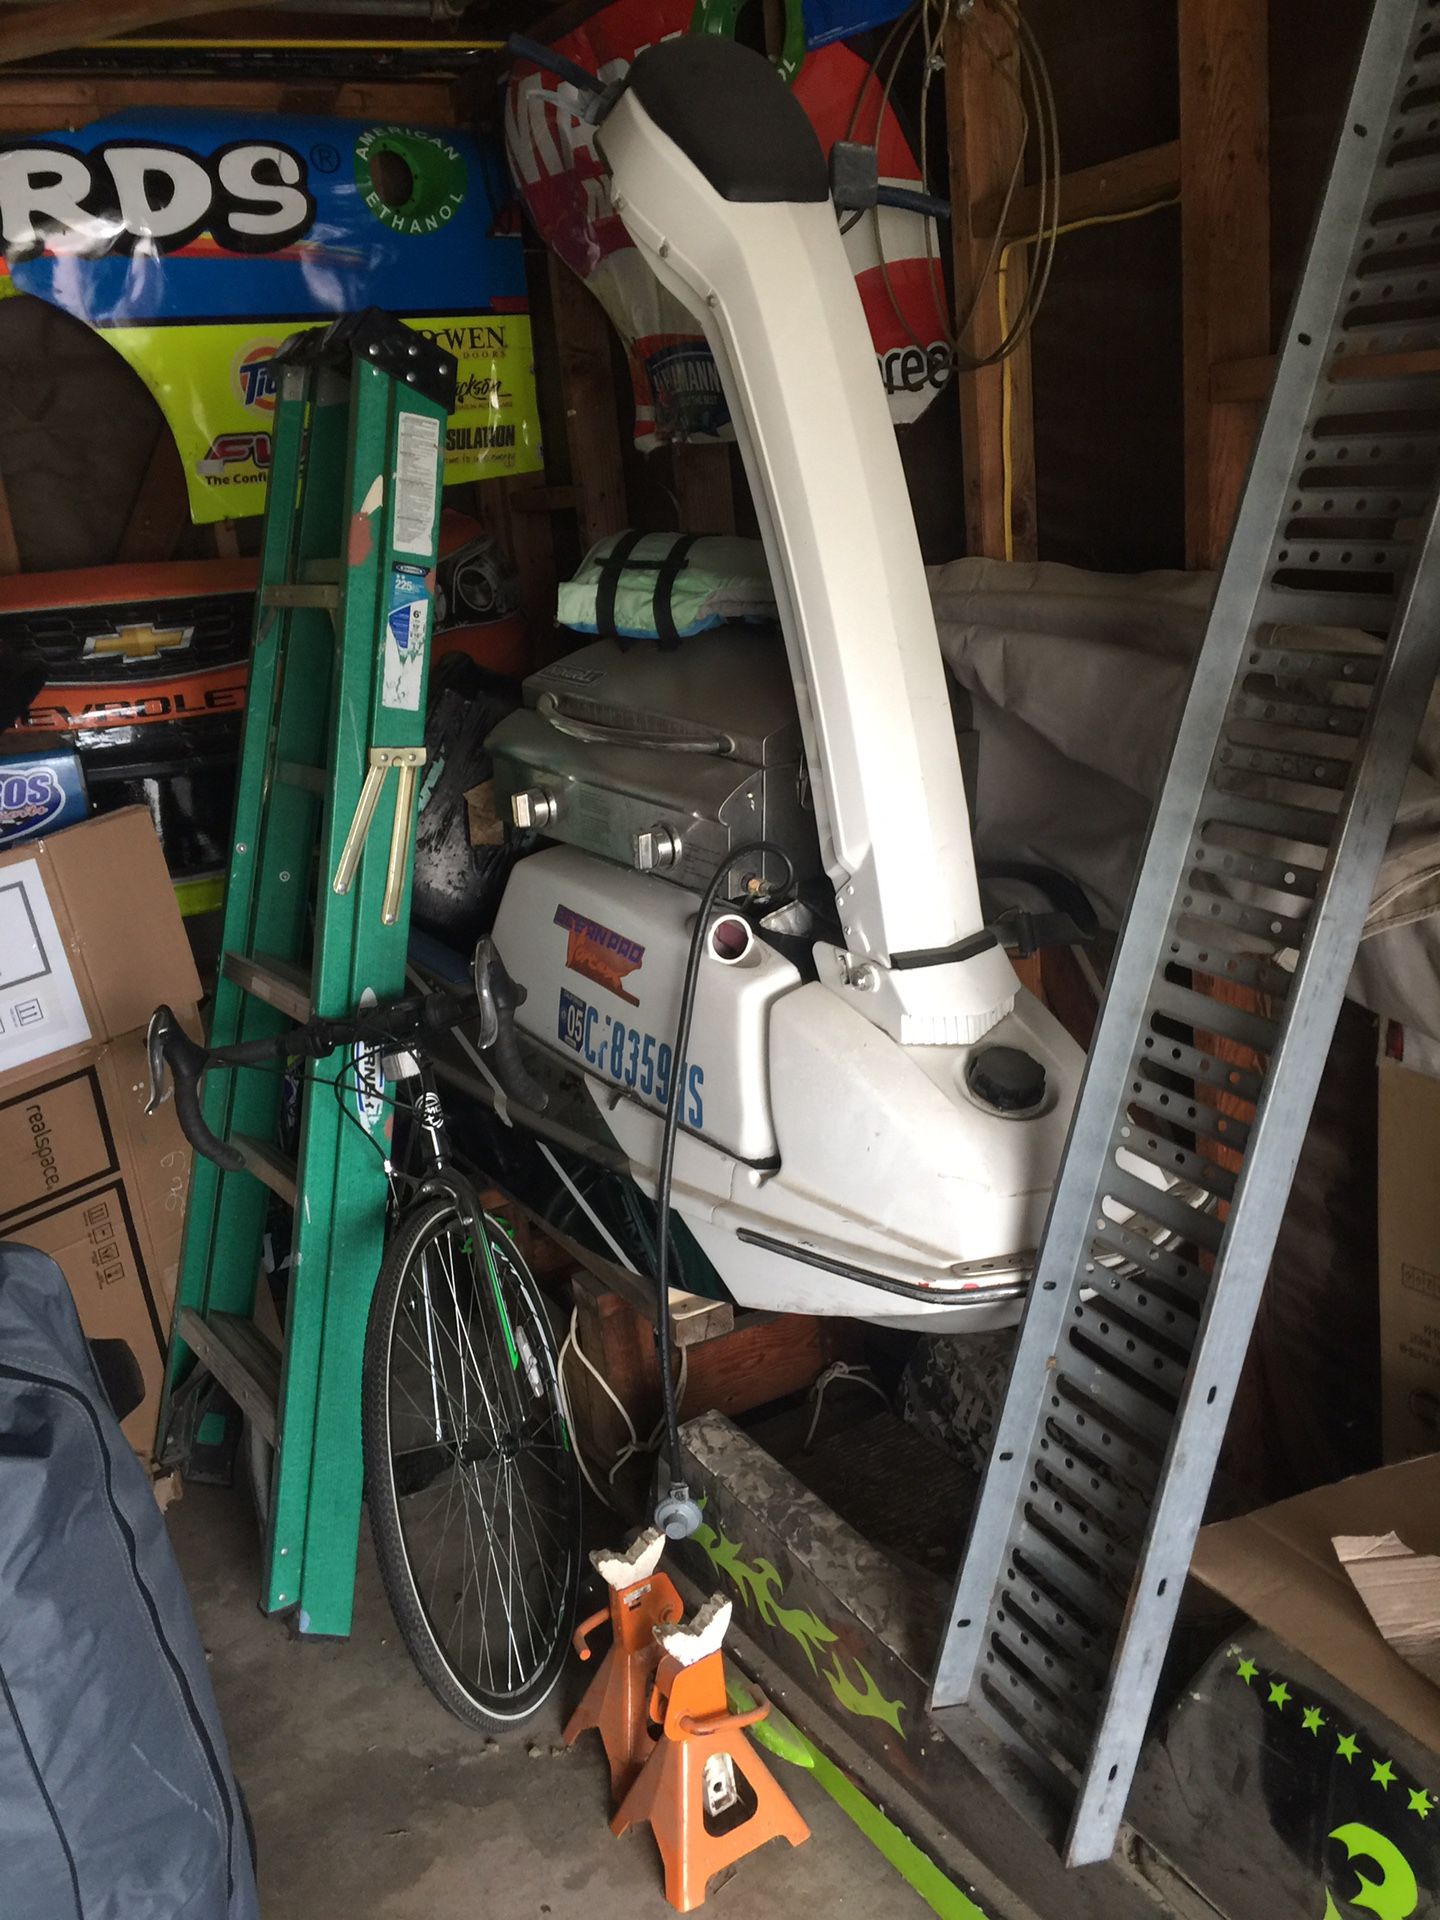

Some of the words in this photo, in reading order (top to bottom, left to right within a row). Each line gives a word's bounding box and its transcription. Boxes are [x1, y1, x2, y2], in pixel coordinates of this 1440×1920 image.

[356, 126, 460, 161] AMERICAN
[0, 145, 308, 246] RDS
[365, 193, 464, 233] ETHANOL
[463, 350, 506, 359] DOORS
[878, 344, 952, 394] ree
[206, 475, 230, 486] The
[395, 580, 412, 591] 225
[0, 774, 50, 808] OS
[567, 1006, 584, 1043] 05
[26, 1104, 60, 1186] realspace
